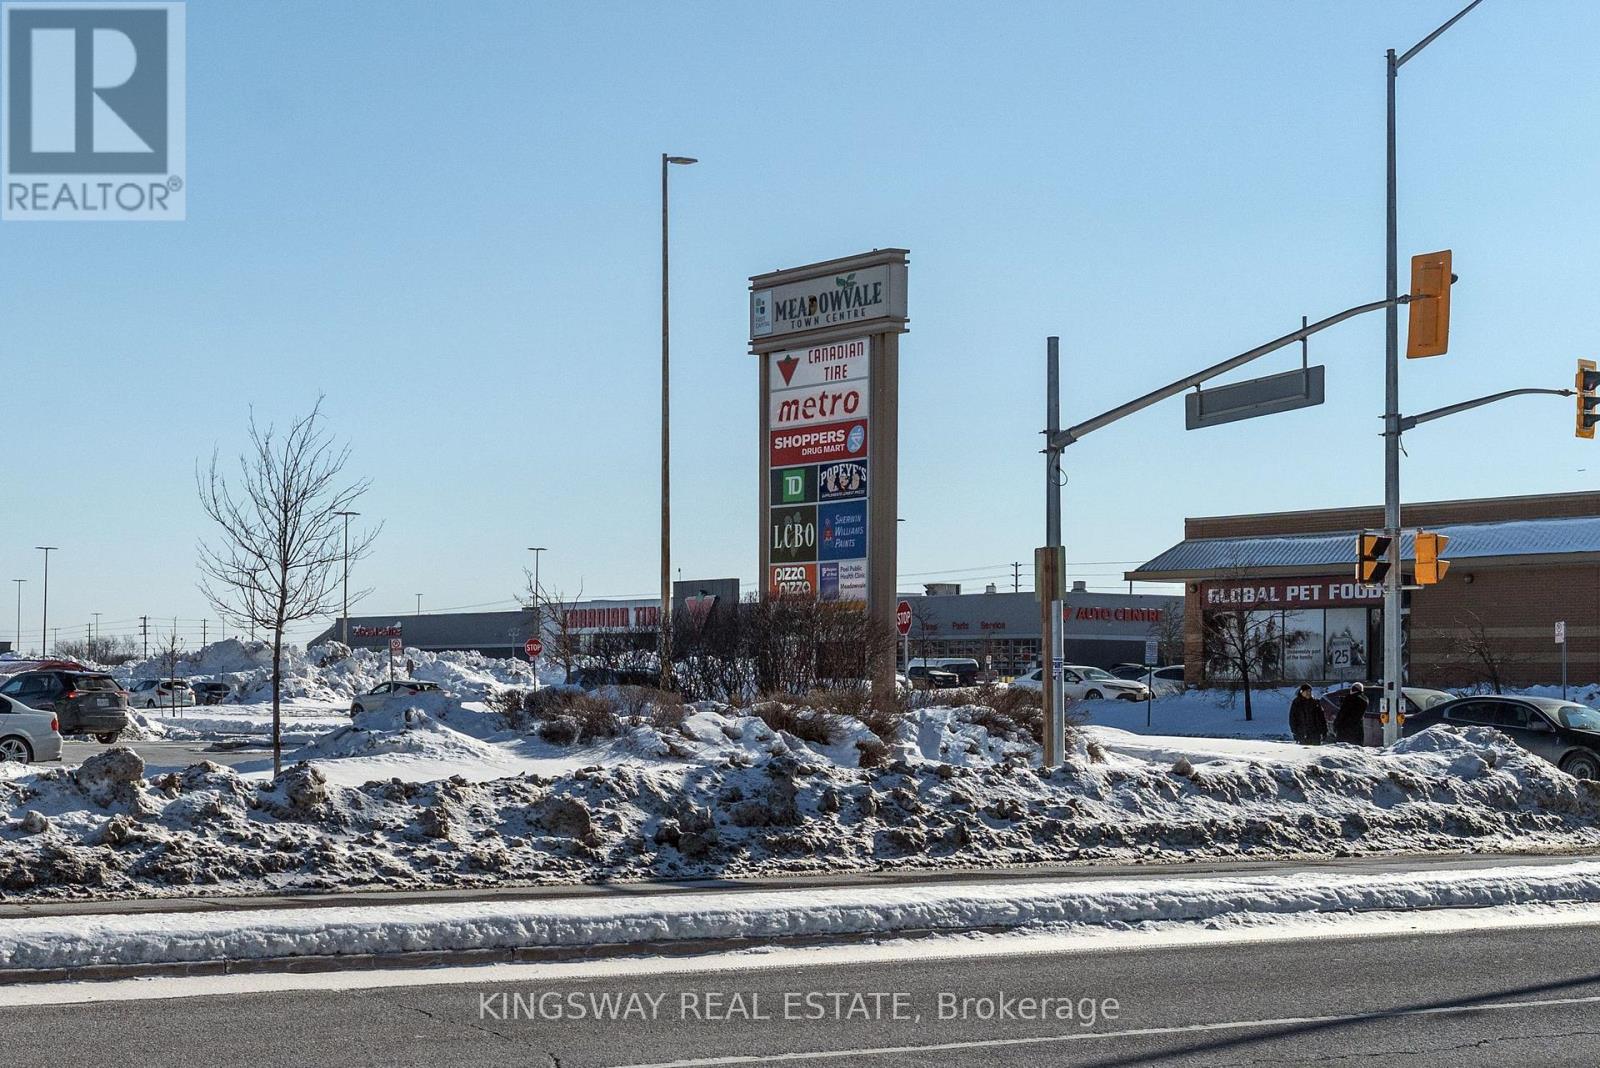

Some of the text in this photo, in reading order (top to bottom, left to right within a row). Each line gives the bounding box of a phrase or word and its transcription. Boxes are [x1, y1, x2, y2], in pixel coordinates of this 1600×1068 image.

[775, 282, 882, 322] MEADOWVALE
[791, 308, 866, 329] TOWN CENTRE
[808, 341, 864, 364] CANADIAN
[824, 364, 848, 381] TIRE
[778, 390, 860, 422] metro
[774, 429, 846, 450] SHOPPERS
[801, 443, 846, 456] DRUG MART
[820, 463, 867, 487] POPEYE'S
[785, 475, 803, 496] TD
[773, 522, 815, 549] LCBO
[834, 539, 856, 549] PAINTS
[1208, 585, 1280, 603] GLOBAL
[1286, 584, 1322, 600] PET
[897, 611, 911, 625] STOP
[1076, 607, 1163, 622] AUTO CENTRE
[526, 644, 542, 652] STOP
[1334, 650, 1349, 665] 25
